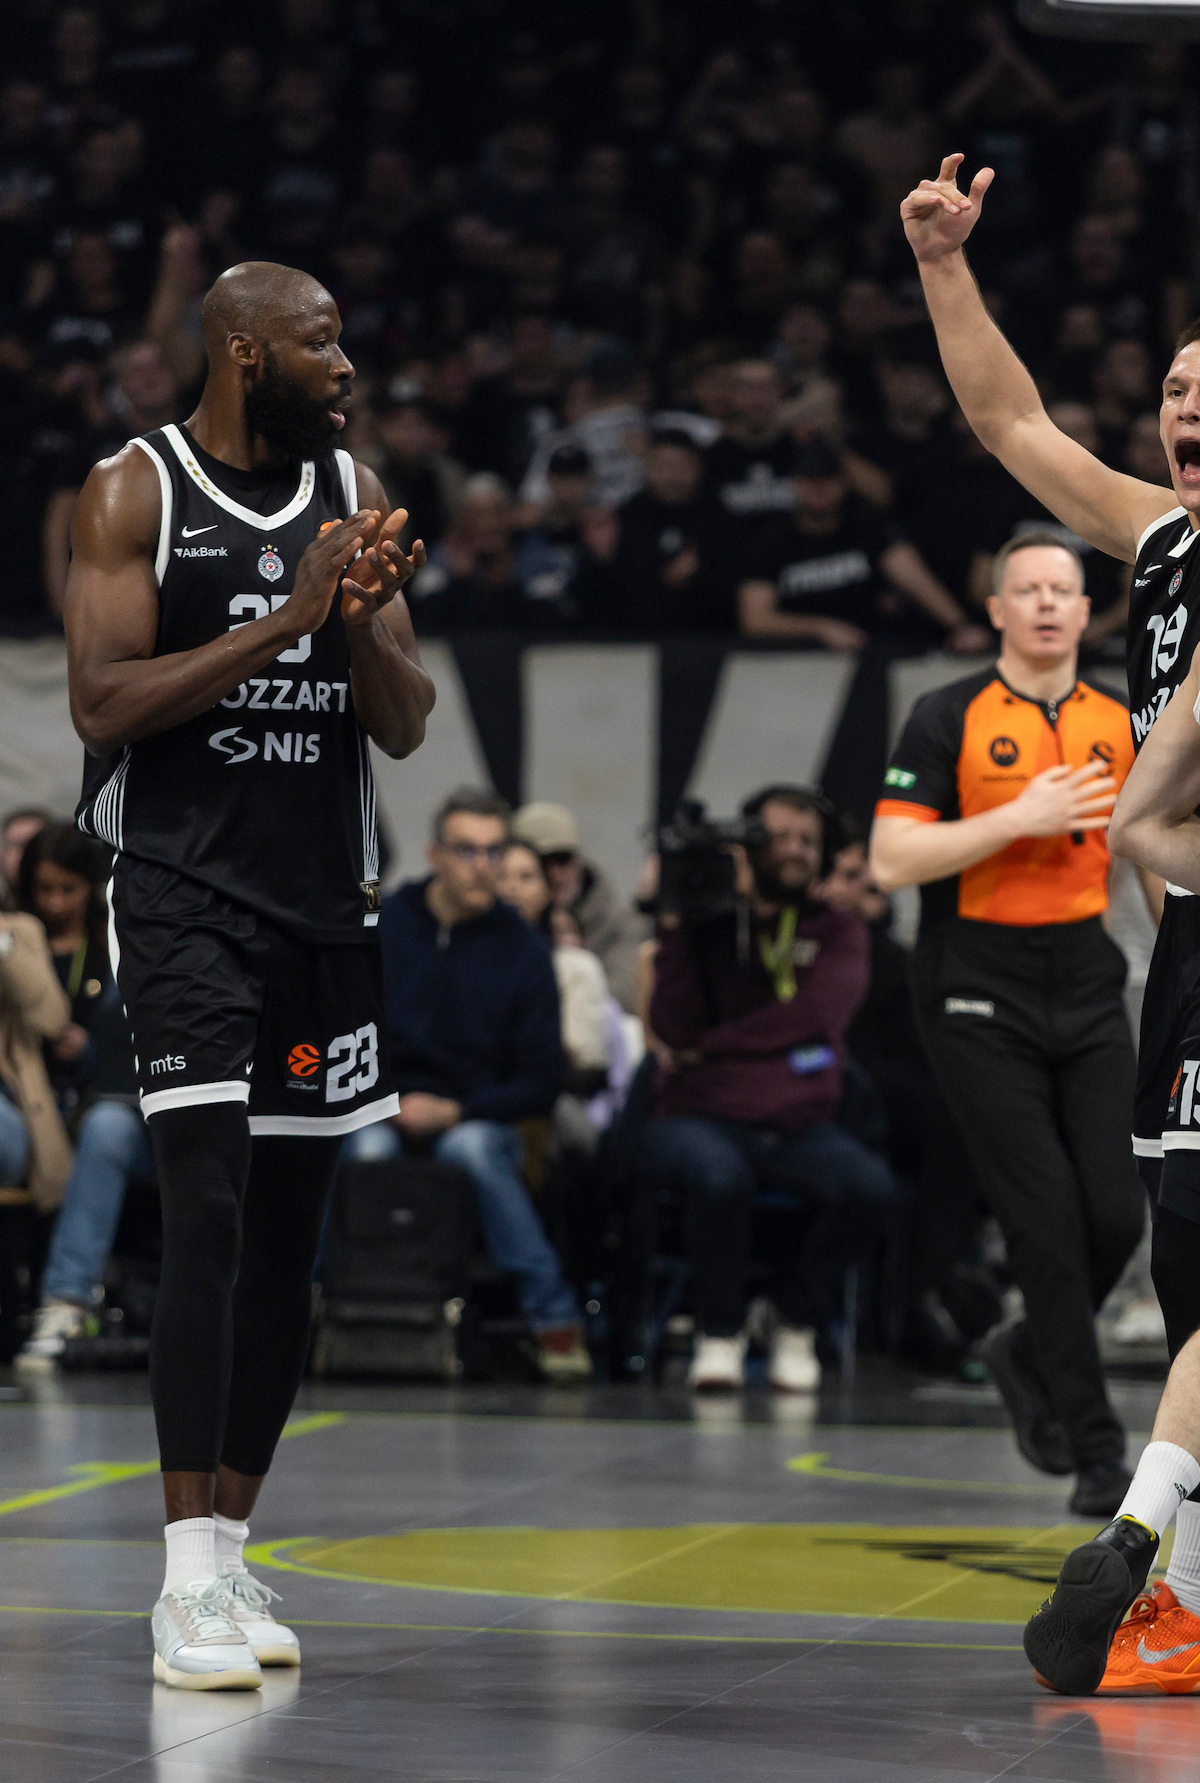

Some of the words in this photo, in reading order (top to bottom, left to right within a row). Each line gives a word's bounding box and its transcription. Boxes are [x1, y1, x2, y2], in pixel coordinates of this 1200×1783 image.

[182, 546, 228, 558] AikBank
[1146, 602, 1188, 680] 19
[217, 678, 348, 713] OZZART
[263, 731, 321, 763] NIS
[150, 1053, 187, 1075] mts
[326, 1021, 379, 1103] 23
